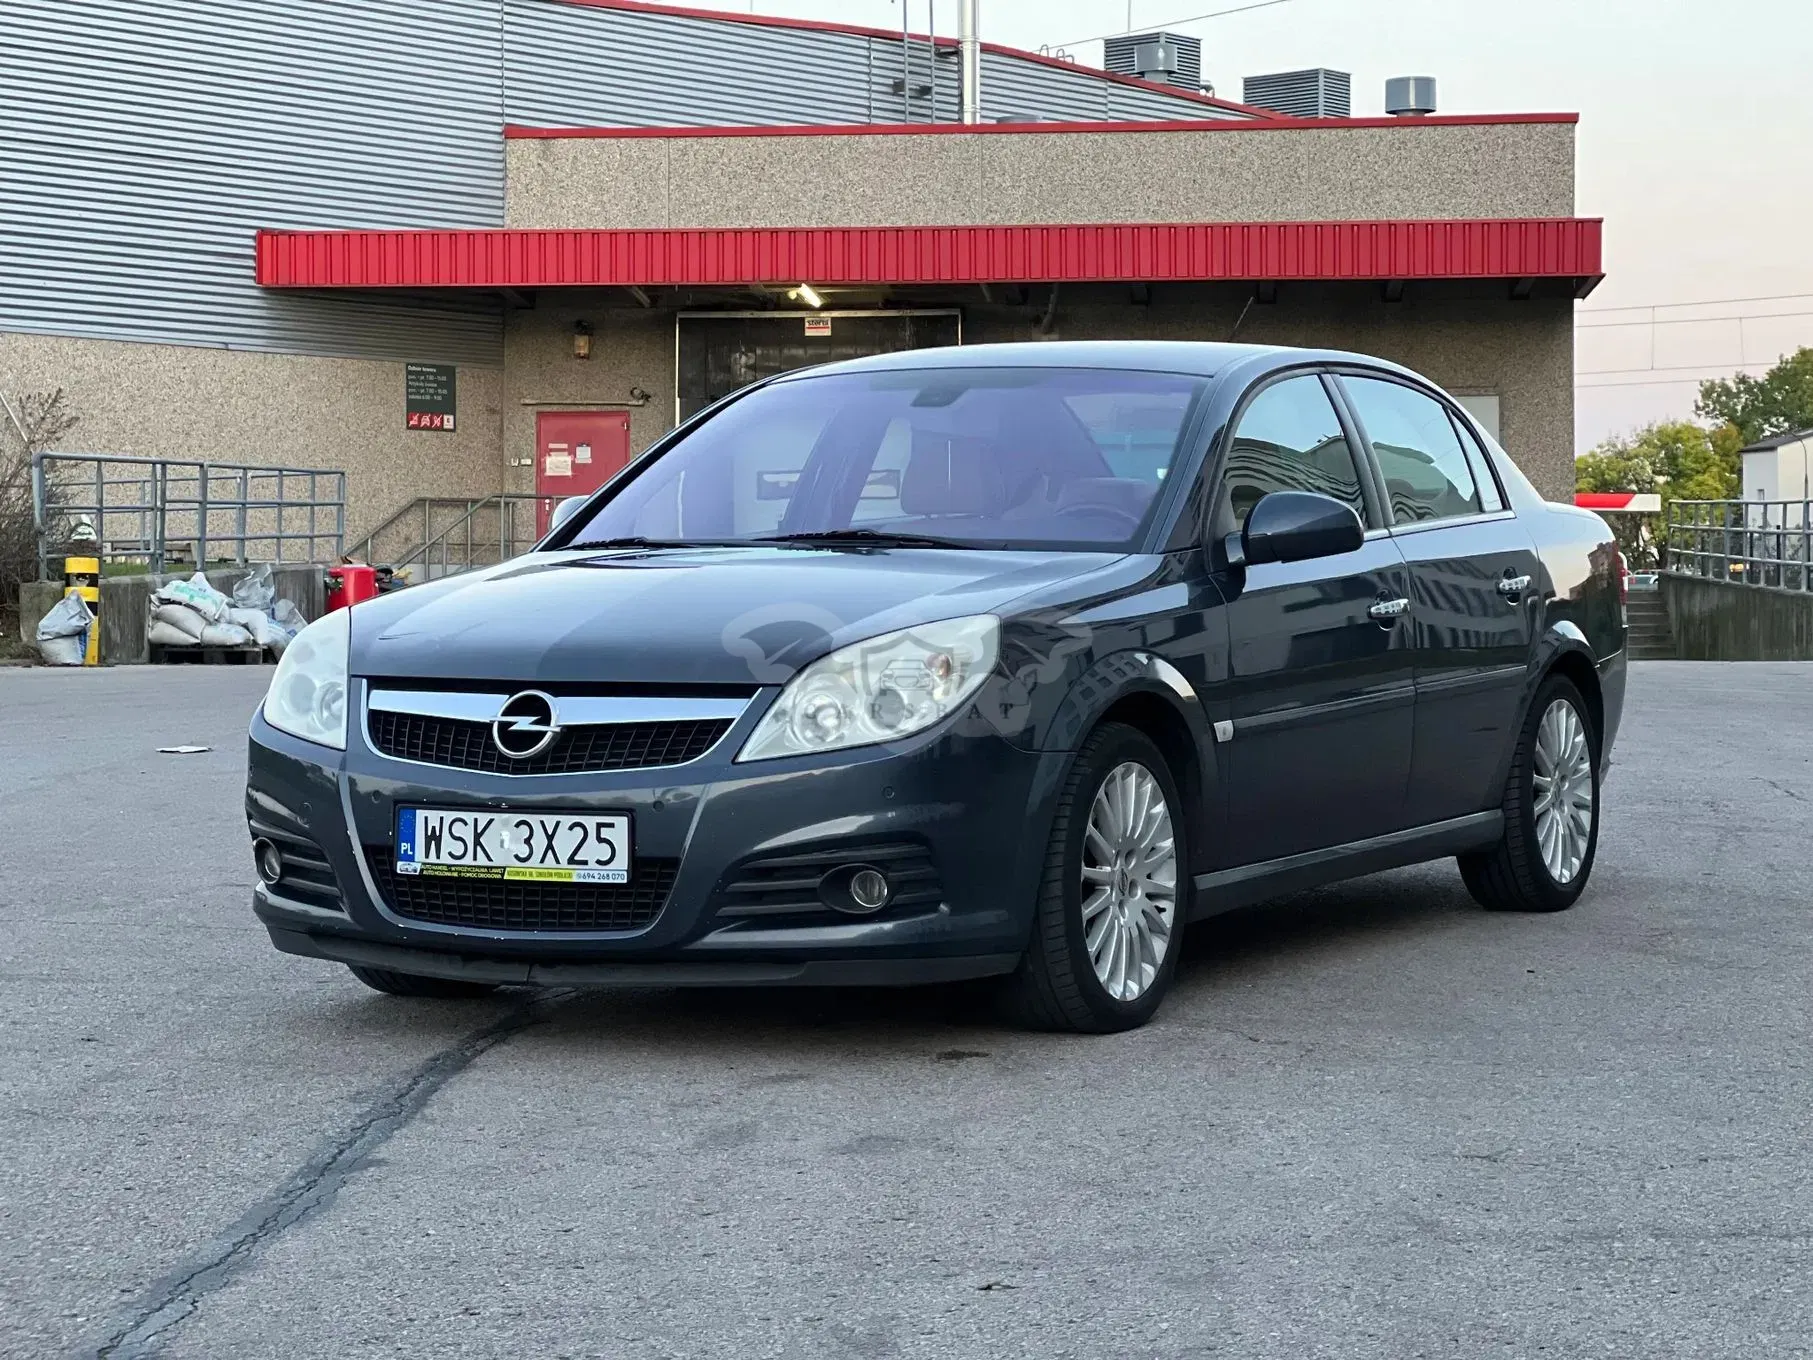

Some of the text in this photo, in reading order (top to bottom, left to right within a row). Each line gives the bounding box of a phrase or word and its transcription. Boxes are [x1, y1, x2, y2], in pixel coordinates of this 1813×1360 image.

[424, 815, 617, 866] WSK 3X25
[400, 842, 413, 855] PL
[611, 873, 626, 881] 070
